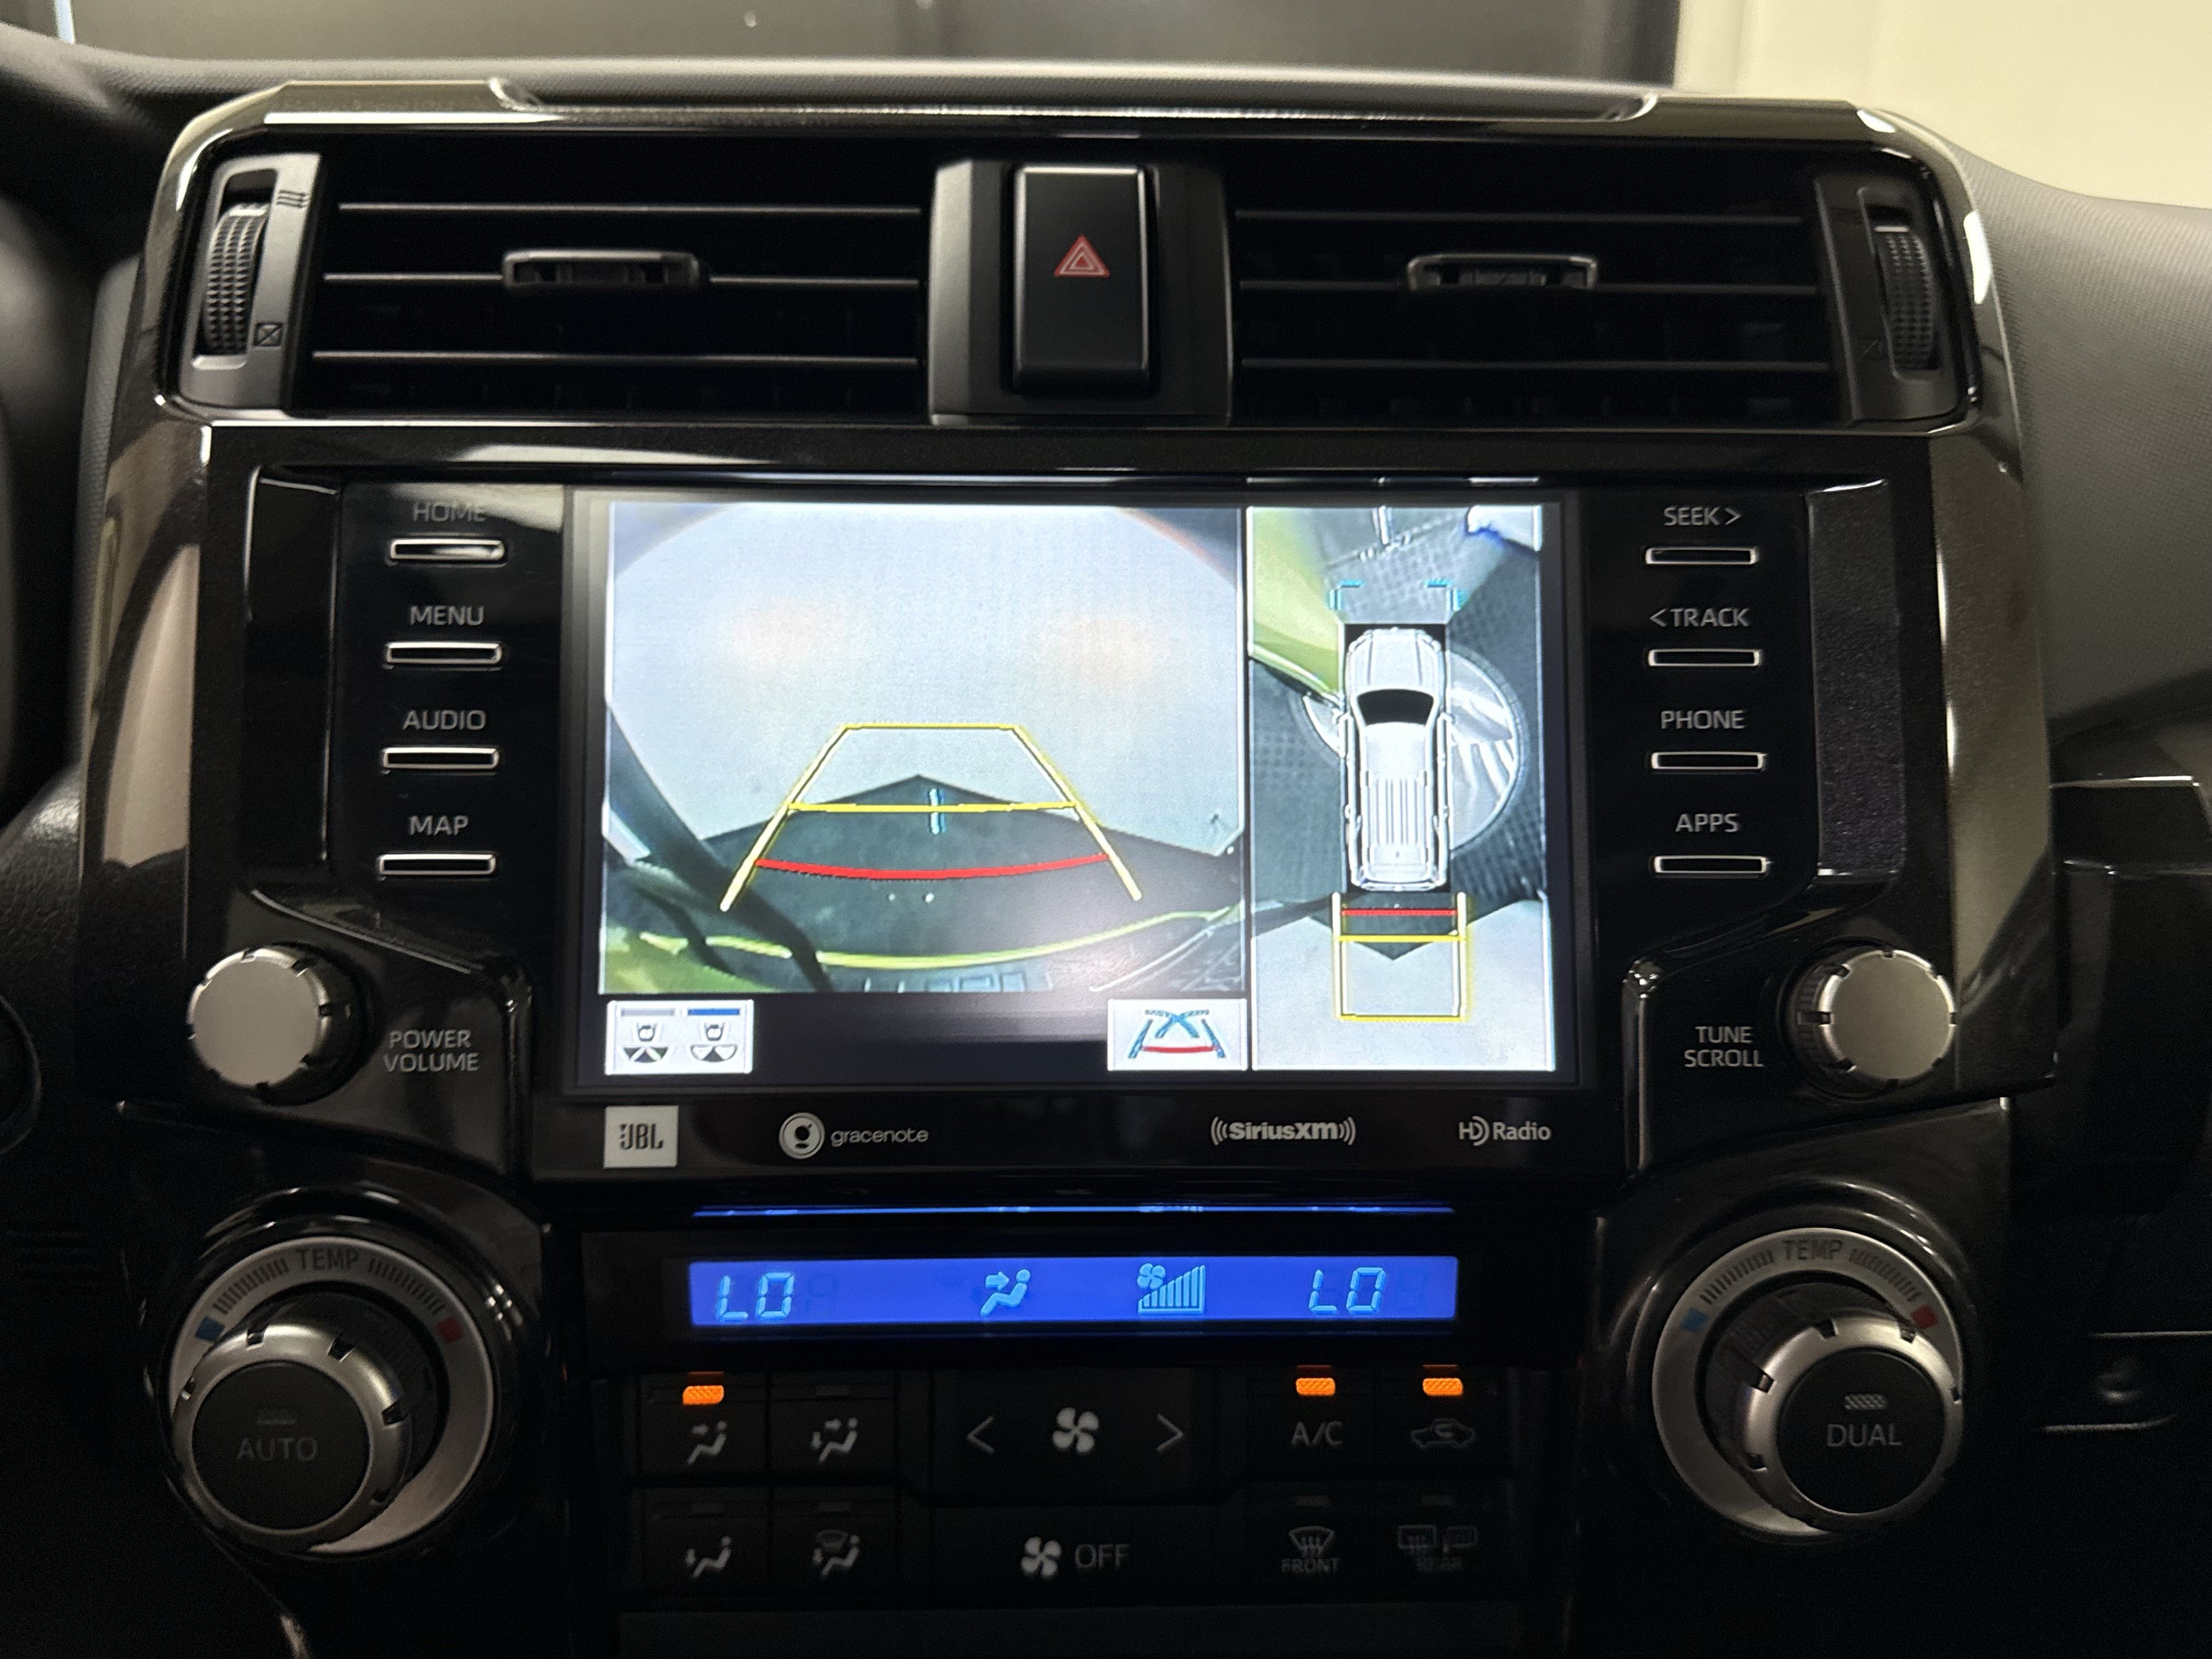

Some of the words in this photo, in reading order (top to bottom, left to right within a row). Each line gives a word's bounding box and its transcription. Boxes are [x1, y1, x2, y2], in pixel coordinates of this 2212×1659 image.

[413, 500, 486, 522] HOME
[1663, 507, 1720, 526] SEEK
[410, 605, 484, 626] MENU
[1669, 607, 1750, 628] TRACK
[402, 710, 488, 731] AUDIO
[1660, 710, 1745, 730] PHONE
[409, 815, 469, 836] MAP
[1675, 813, 1740, 833] APPS
[390, 1029, 472, 1049] POWER
[1695, 1026, 1753, 1043] TUNE
[383, 1052, 480, 1073] VOLUME
[1684, 1049, 1764, 1068] SCROLL
[619, 1122, 664, 1150] JBL
[831, 1127, 929, 1148] gracenote
[1493, 1122, 1552, 1141] Radio
[296, 1247, 360, 1271] TEMP
[1783, 1239, 1844, 1260] TEMP
[1290, 1421, 1344, 1447] A/C
[1827, 1423, 1903, 1447] DUAL
[237, 1436, 318, 1462] AUTO
[1074, 1543, 1130, 1569] OFF
[1281, 1557, 1340, 1574] FRONT
